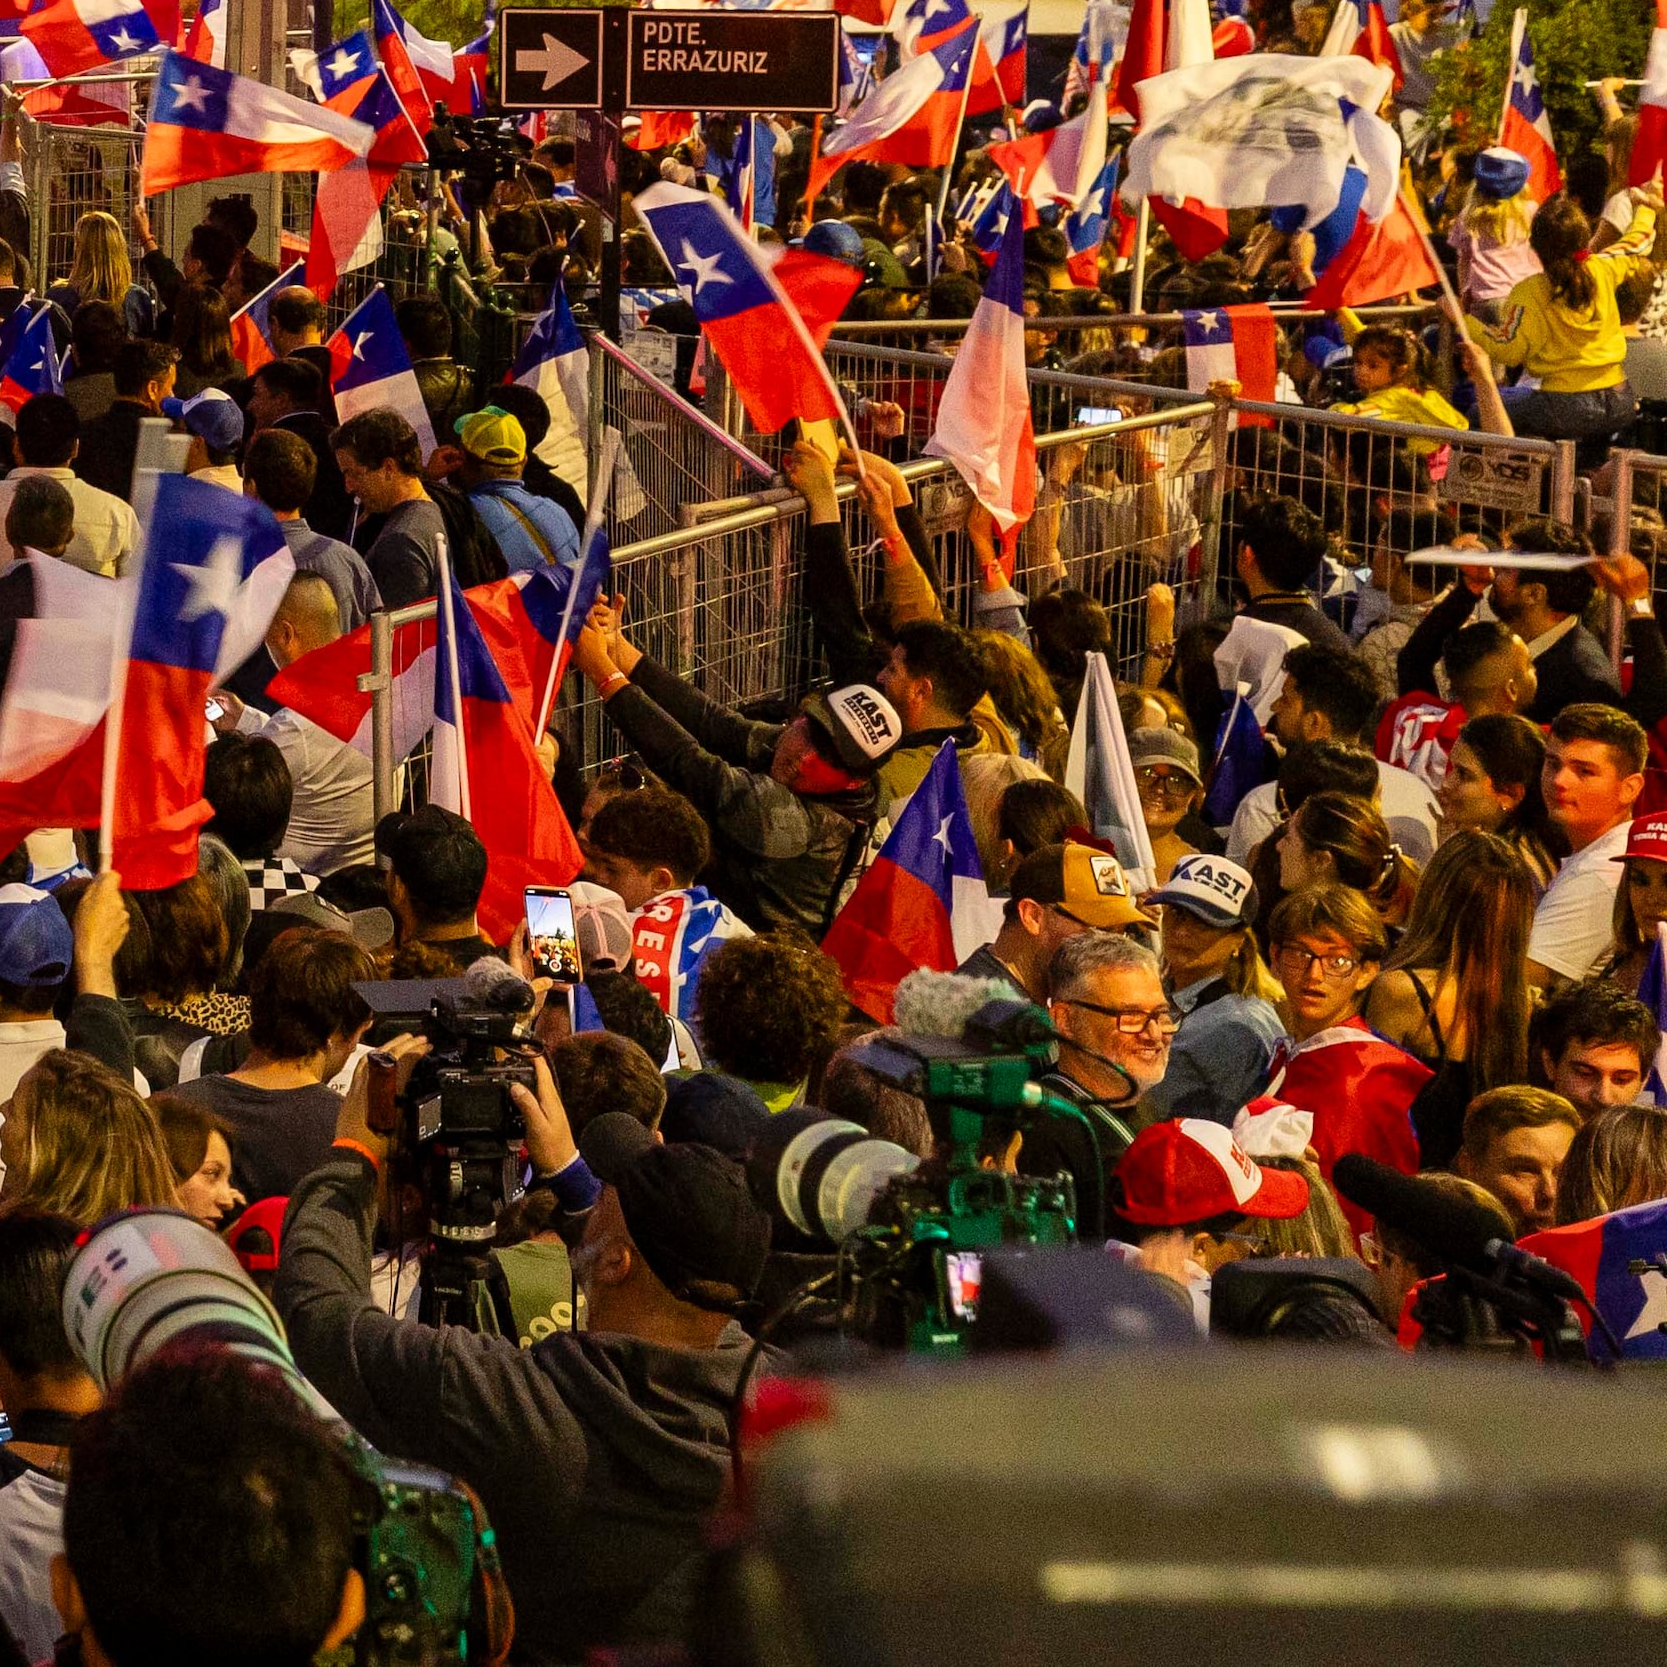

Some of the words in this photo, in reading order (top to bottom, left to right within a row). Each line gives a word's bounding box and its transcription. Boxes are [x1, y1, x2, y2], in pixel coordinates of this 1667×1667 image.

[643, 21, 707, 46] PDTE.
[643, 50, 768, 74] ERRAZURIZ
[851, 691, 892, 738] KAST
